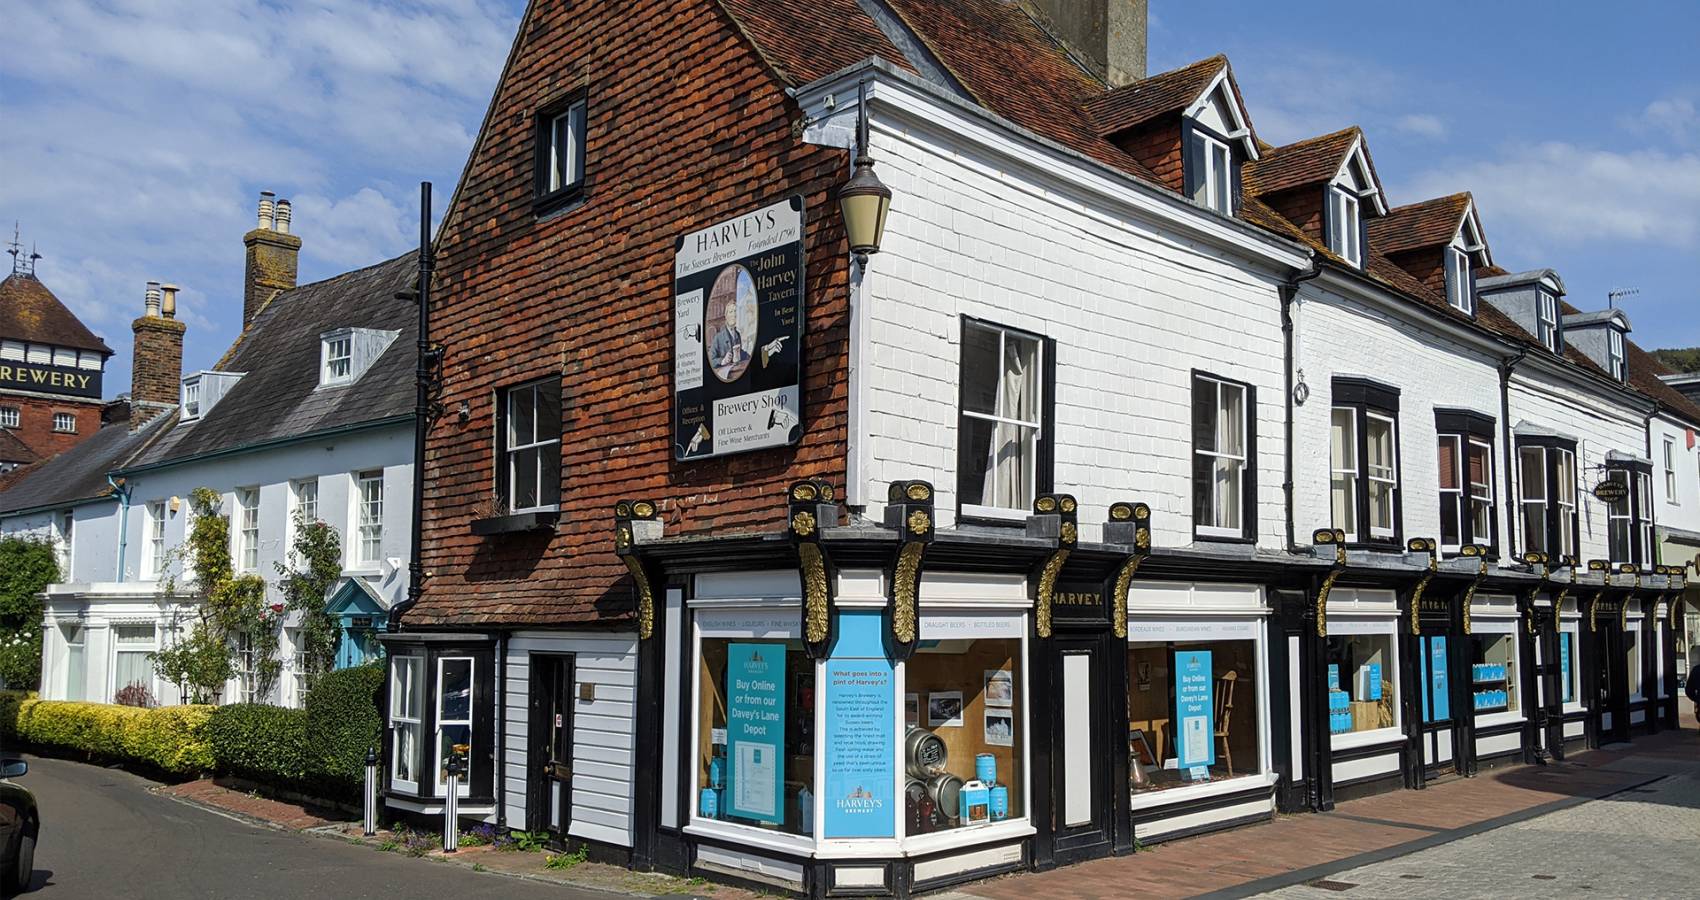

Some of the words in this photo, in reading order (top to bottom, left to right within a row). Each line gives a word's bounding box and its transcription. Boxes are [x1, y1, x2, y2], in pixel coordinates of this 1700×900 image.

[697, 209, 775, 254] HARVEYS
[679, 263, 691, 274] The
[692, 257, 712, 269] Sussex
[712, 249, 737, 263] Brewers
[748, 235, 778, 251] Founded
[758, 254, 785, 272] John
[757, 268, 798, 290] Harvey
[677, 295, 700, 307] Brewery
[768, 288, 795, 302] Tavern
[677, 308, 690, 319] Yard
[0, 366, 90, 389] REWERY
[718, 400, 760, 417] Brewery
[762, 394, 788, 410] Shop
[726, 426, 746, 435] Licence
[746, 424, 752, 432] &
[718, 439, 728, 447] Fine
[730, 436, 742, 445] Wine
[852, 671, 867, 679] goes
[1182, 675, 1192, 683] Buy
[736, 680, 750, 692] Buy
[752, 680, 776, 691] Online
[856, 679, 887, 687] Harvey's?
[735, 696, 743, 704] or
[744, 695, 762, 705] from
[763, 698, 776, 706] our
[1180, 695, 1197, 703] Davey's
[1198, 694, 1208, 702] Lane
[1188, 704, 1202, 712] Depot
[732, 708, 760, 720] Davey's
[761, 710, 780, 721] Lane
[744, 724, 766, 736] Depot
[836, 800, 883, 808] HARVEY'S
